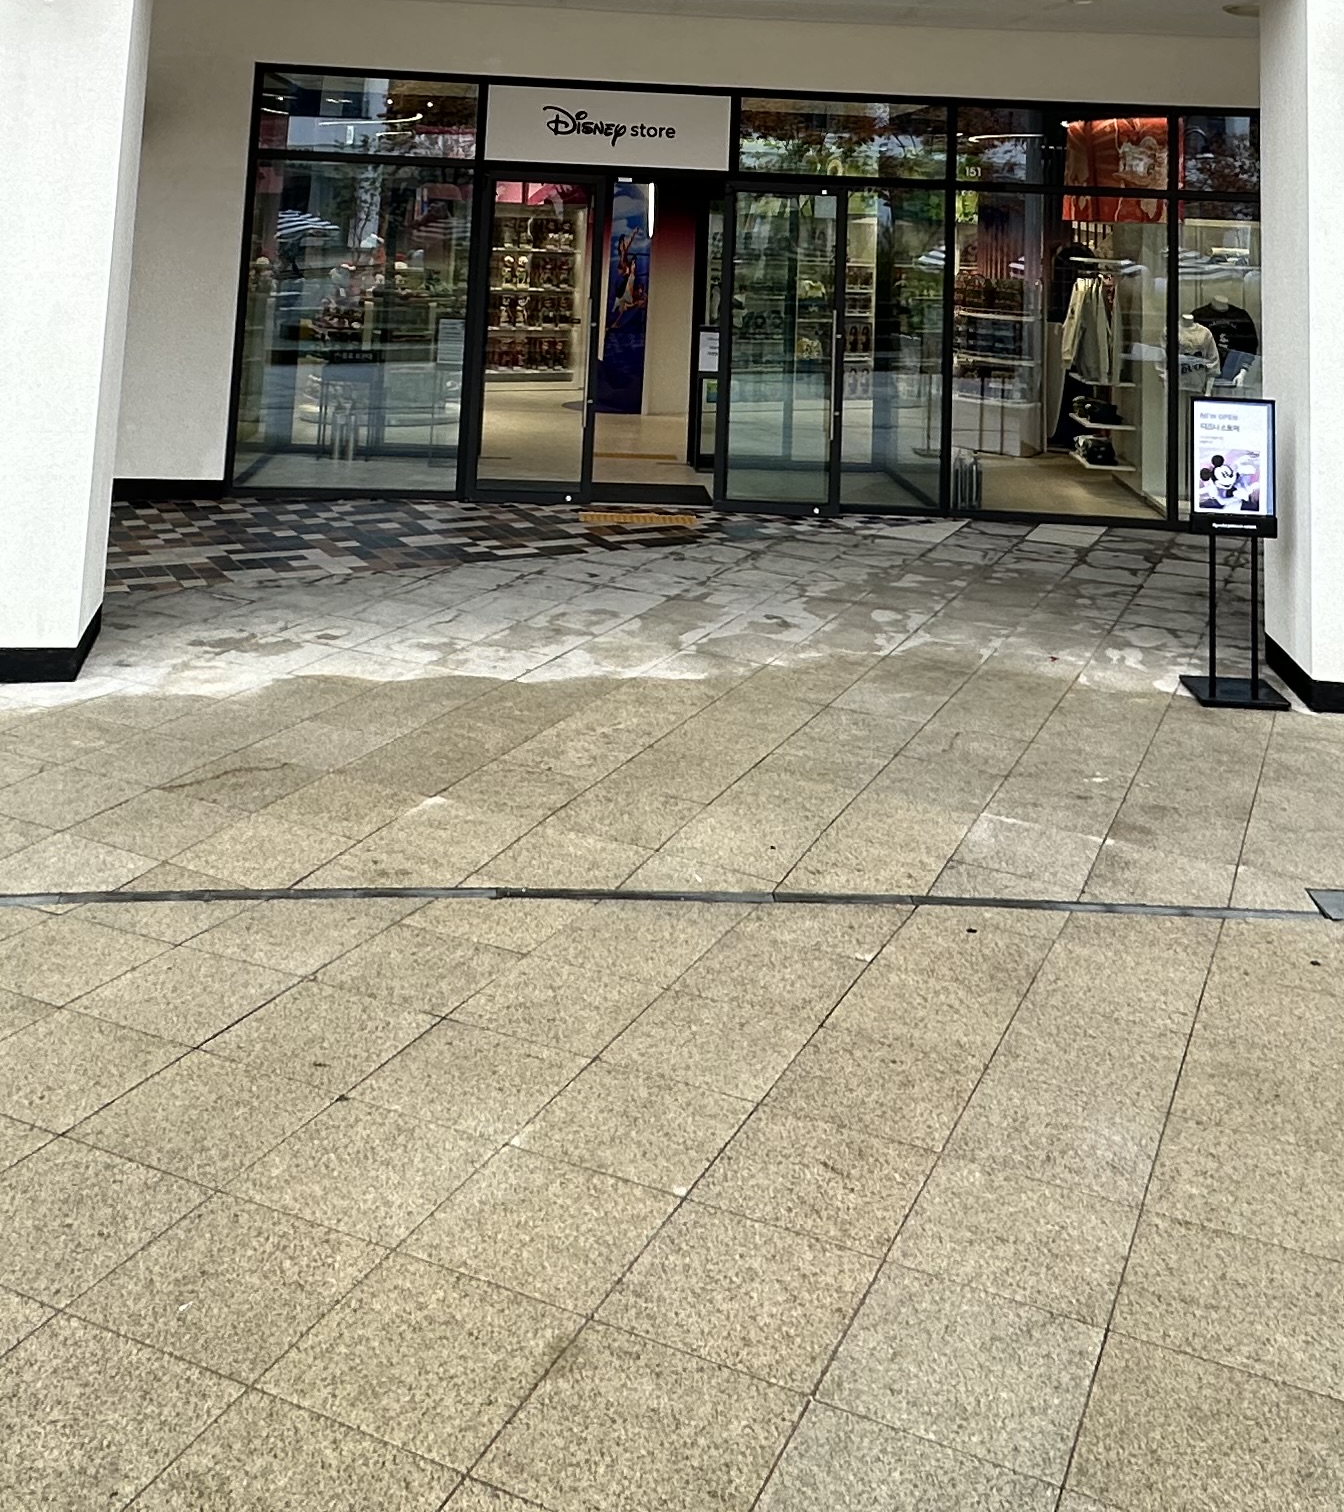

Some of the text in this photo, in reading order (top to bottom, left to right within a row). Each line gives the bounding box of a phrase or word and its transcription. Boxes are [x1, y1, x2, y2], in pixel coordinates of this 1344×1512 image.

[542, 105, 676, 147] Disney store
[964, 166, 982, 178] 151
